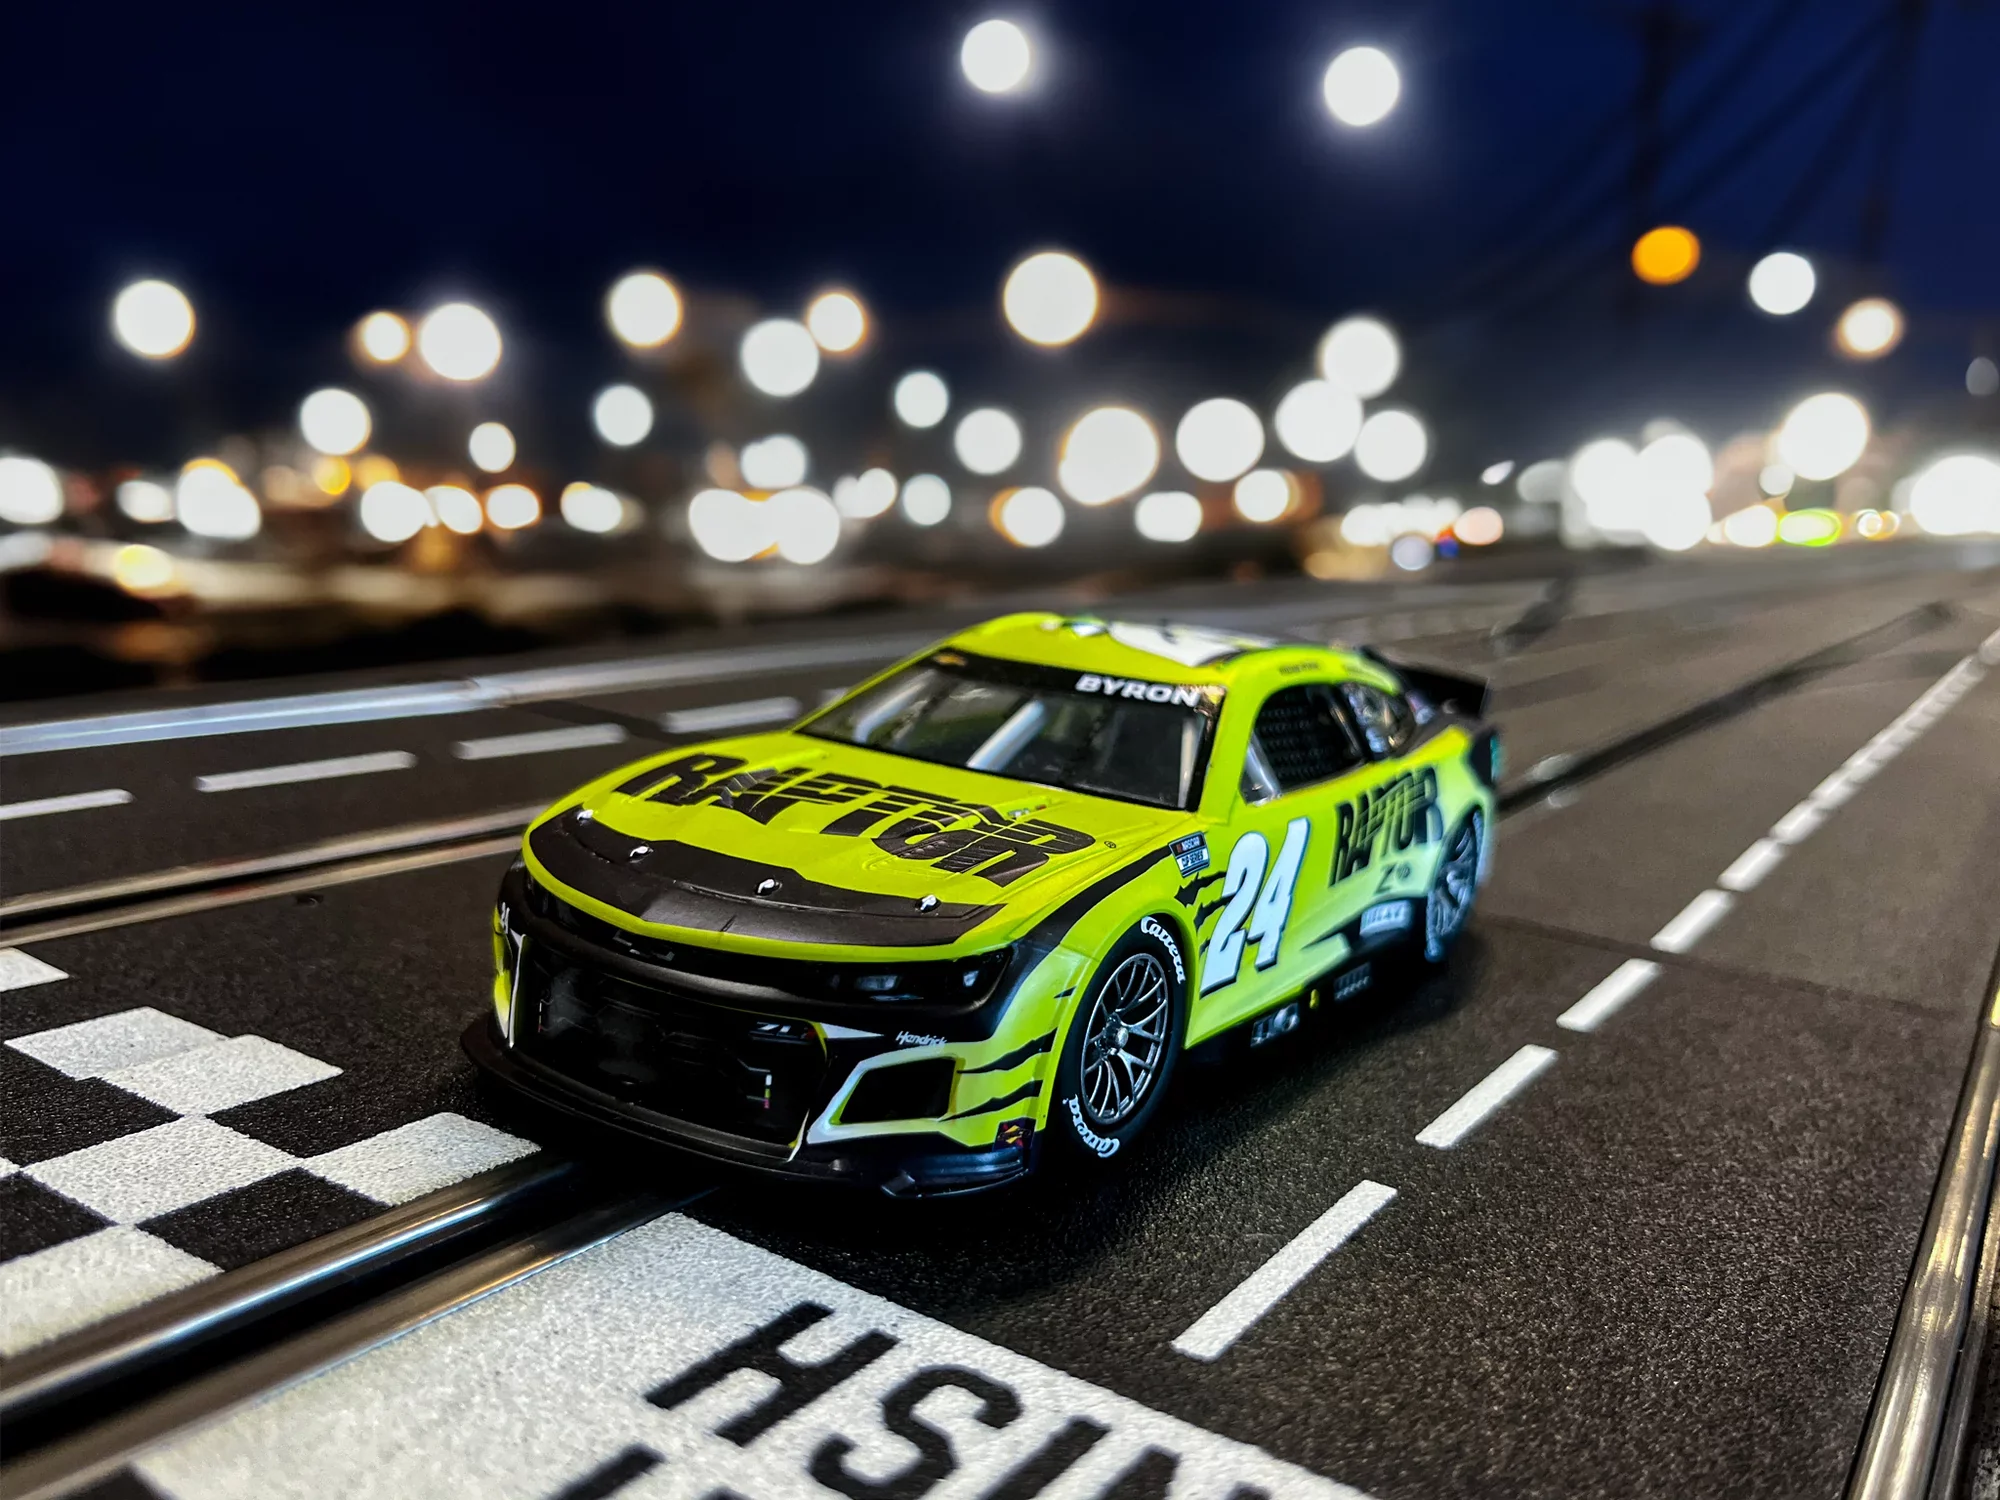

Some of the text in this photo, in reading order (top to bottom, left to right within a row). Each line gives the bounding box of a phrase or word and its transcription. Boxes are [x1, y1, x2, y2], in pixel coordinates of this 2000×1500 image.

[1075, 673, 1200, 707] BYRON
[611, 753, 1096, 888] RAPTOR
[1181, 836, 1201, 852] NASCAR
[1328, 766, 1445, 888] RAPTOR
[1199, 816, 1311, 1000] 24
[1140, 915, 1187, 985] Carrera
[895, 1031, 948, 1047] Hendrick
[1062, 1093, 1121, 1159] Carrera
